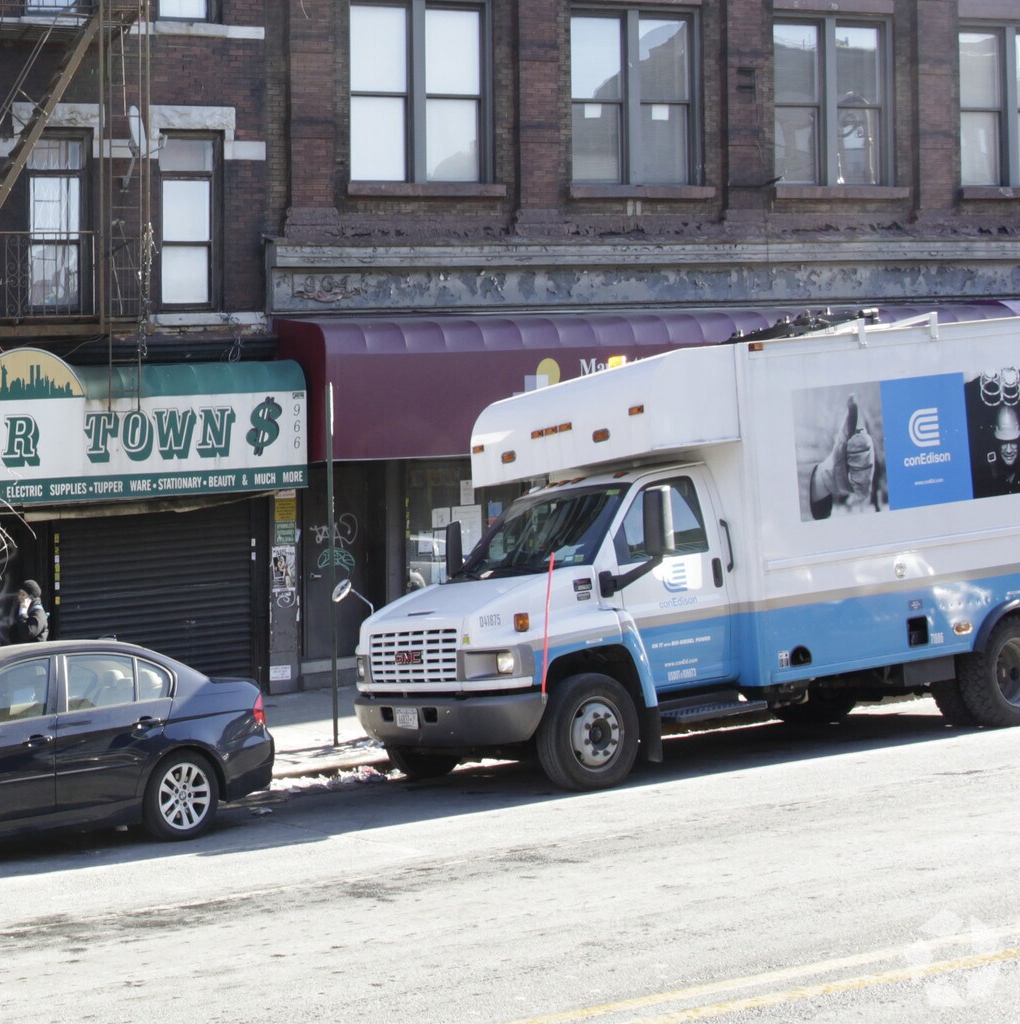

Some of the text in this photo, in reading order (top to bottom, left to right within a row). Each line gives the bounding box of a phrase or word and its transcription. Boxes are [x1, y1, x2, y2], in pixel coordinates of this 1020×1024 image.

[84, 406, 236, 463] TOWN
[904, 452, 951, 467] conEdison
[7, 484, 43, 498] ELECTRIC
[50, 482, 87, 496] SUPPLIES
[94, 481, 123, 494] TUPPER
[130, 479, 152, 492] WARE
[158, 476, 201, 491] STATIONARY
[208, 474, 236, 488] BEAUTY
[242, 474, 248, 486] &
[254, 472, 276, 485] MUCH
[283, 471, 303, 483] MORE
[659, 596, 697, 609] conEdison
[395, 651, 421, 664] GMC
